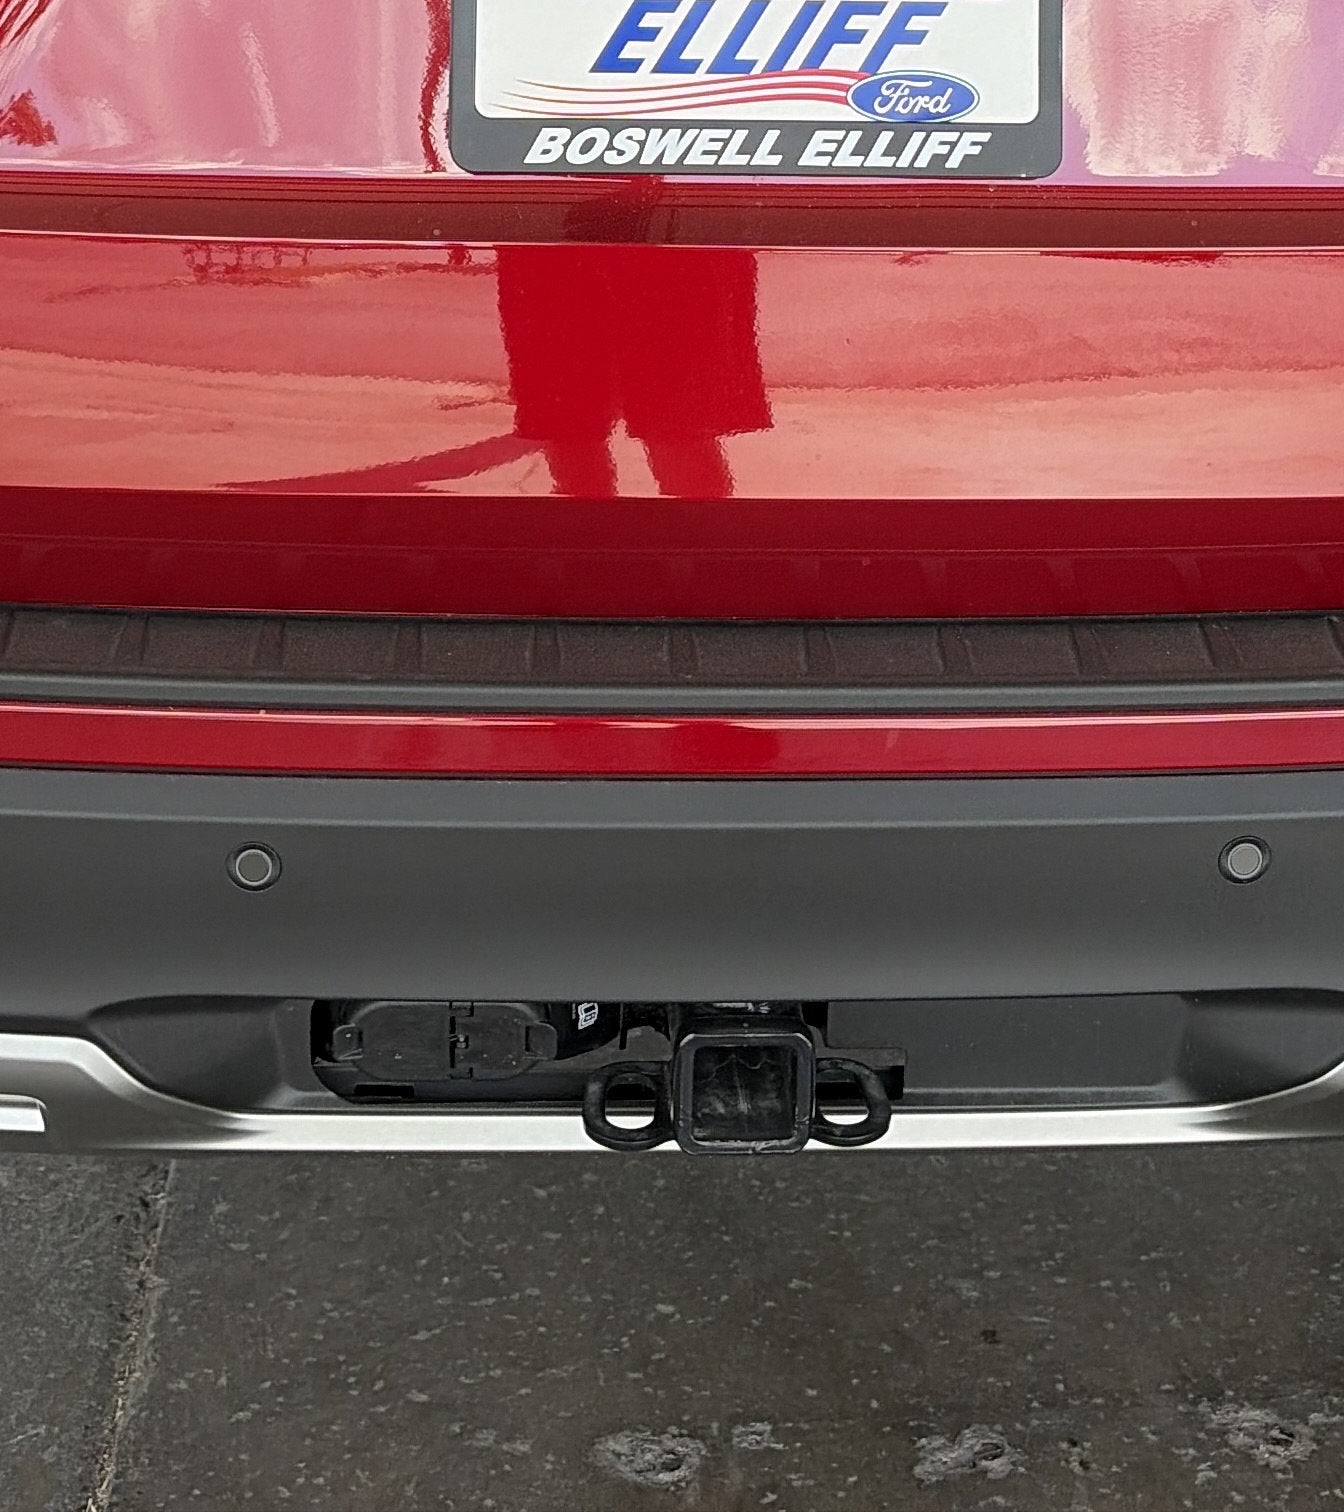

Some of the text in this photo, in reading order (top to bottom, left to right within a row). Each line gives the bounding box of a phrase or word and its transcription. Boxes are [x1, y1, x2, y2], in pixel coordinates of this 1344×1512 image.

[872, 79, 953, 116] Ford
[524, 127, 991, 169] BOSWELL ELLIFF
